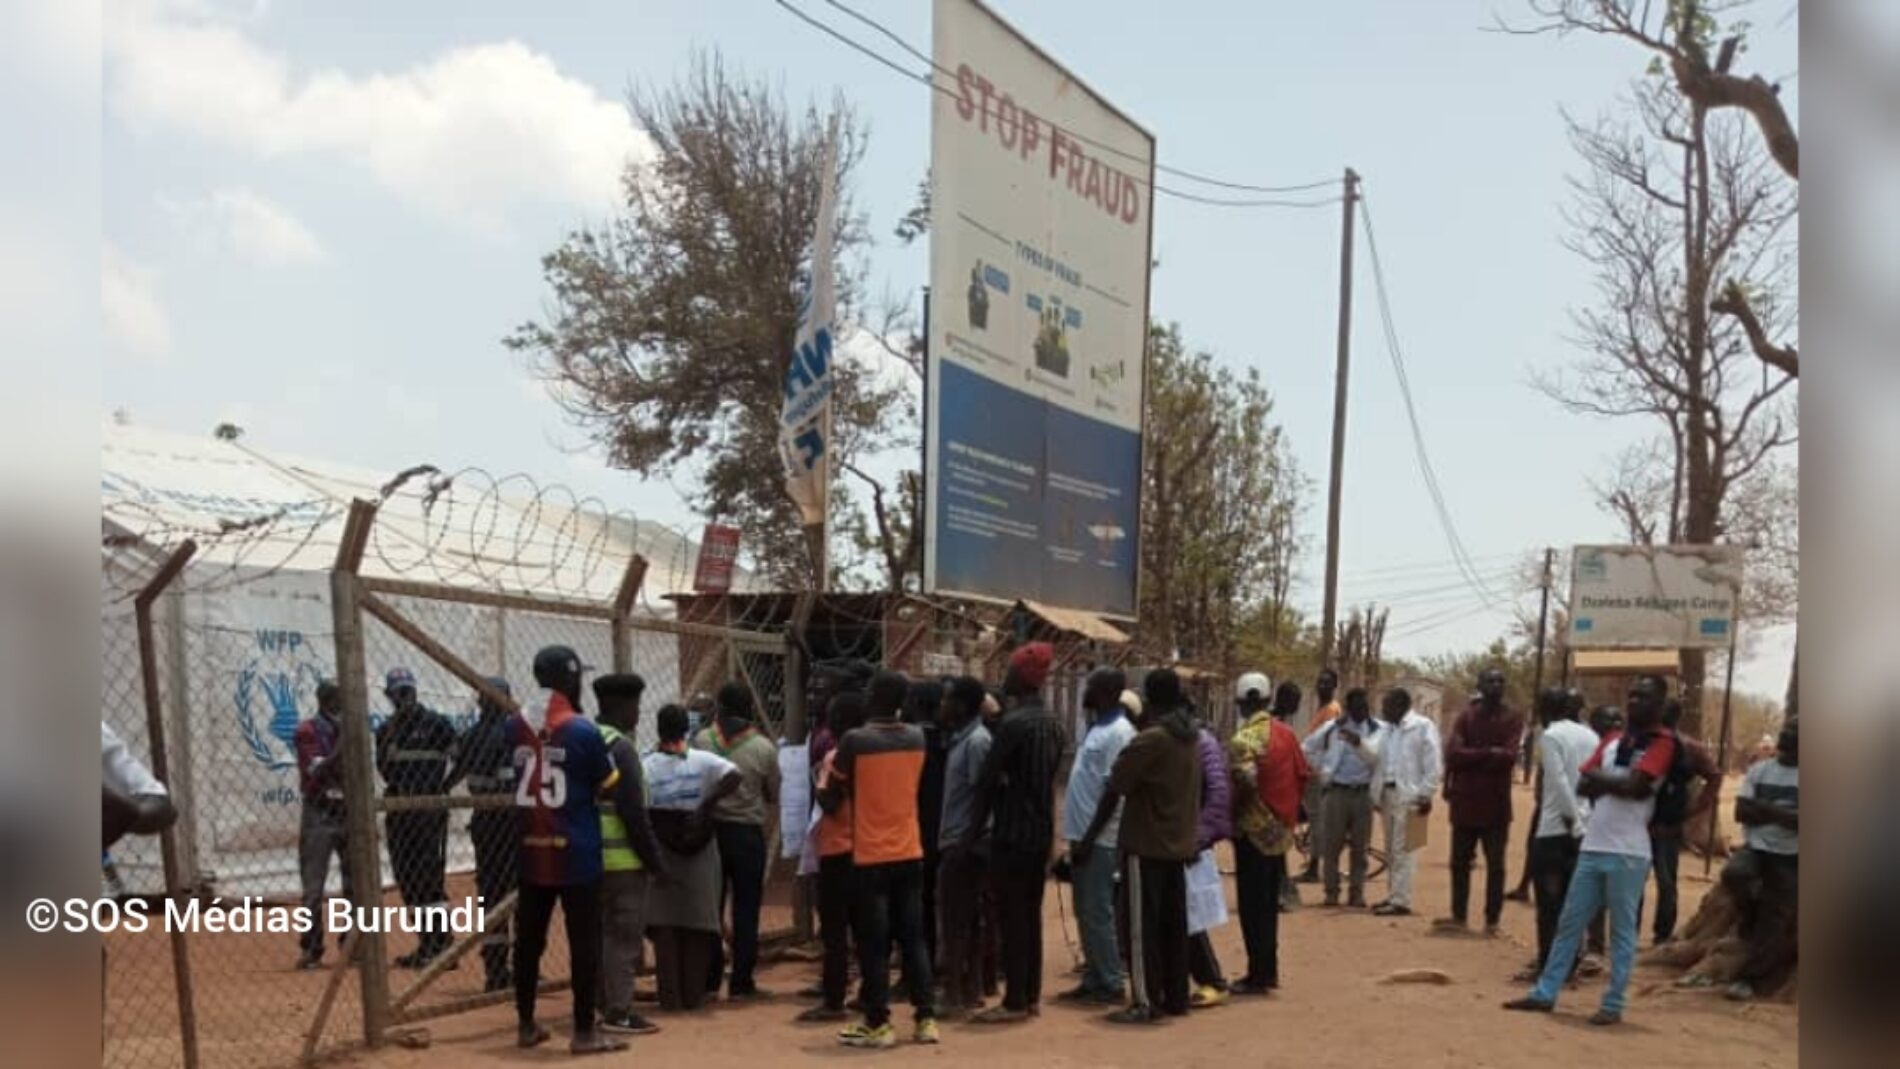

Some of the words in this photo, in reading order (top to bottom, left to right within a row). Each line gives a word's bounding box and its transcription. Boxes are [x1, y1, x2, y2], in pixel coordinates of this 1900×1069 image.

[956, 63, 1040, 160] STOP
[1050, 124, 1139, 224] FRAUD
[1635, 595, 1686, 612] Refugee
[256, 630, 302, 651] WFP
[514, 744, 568, 808] 25
